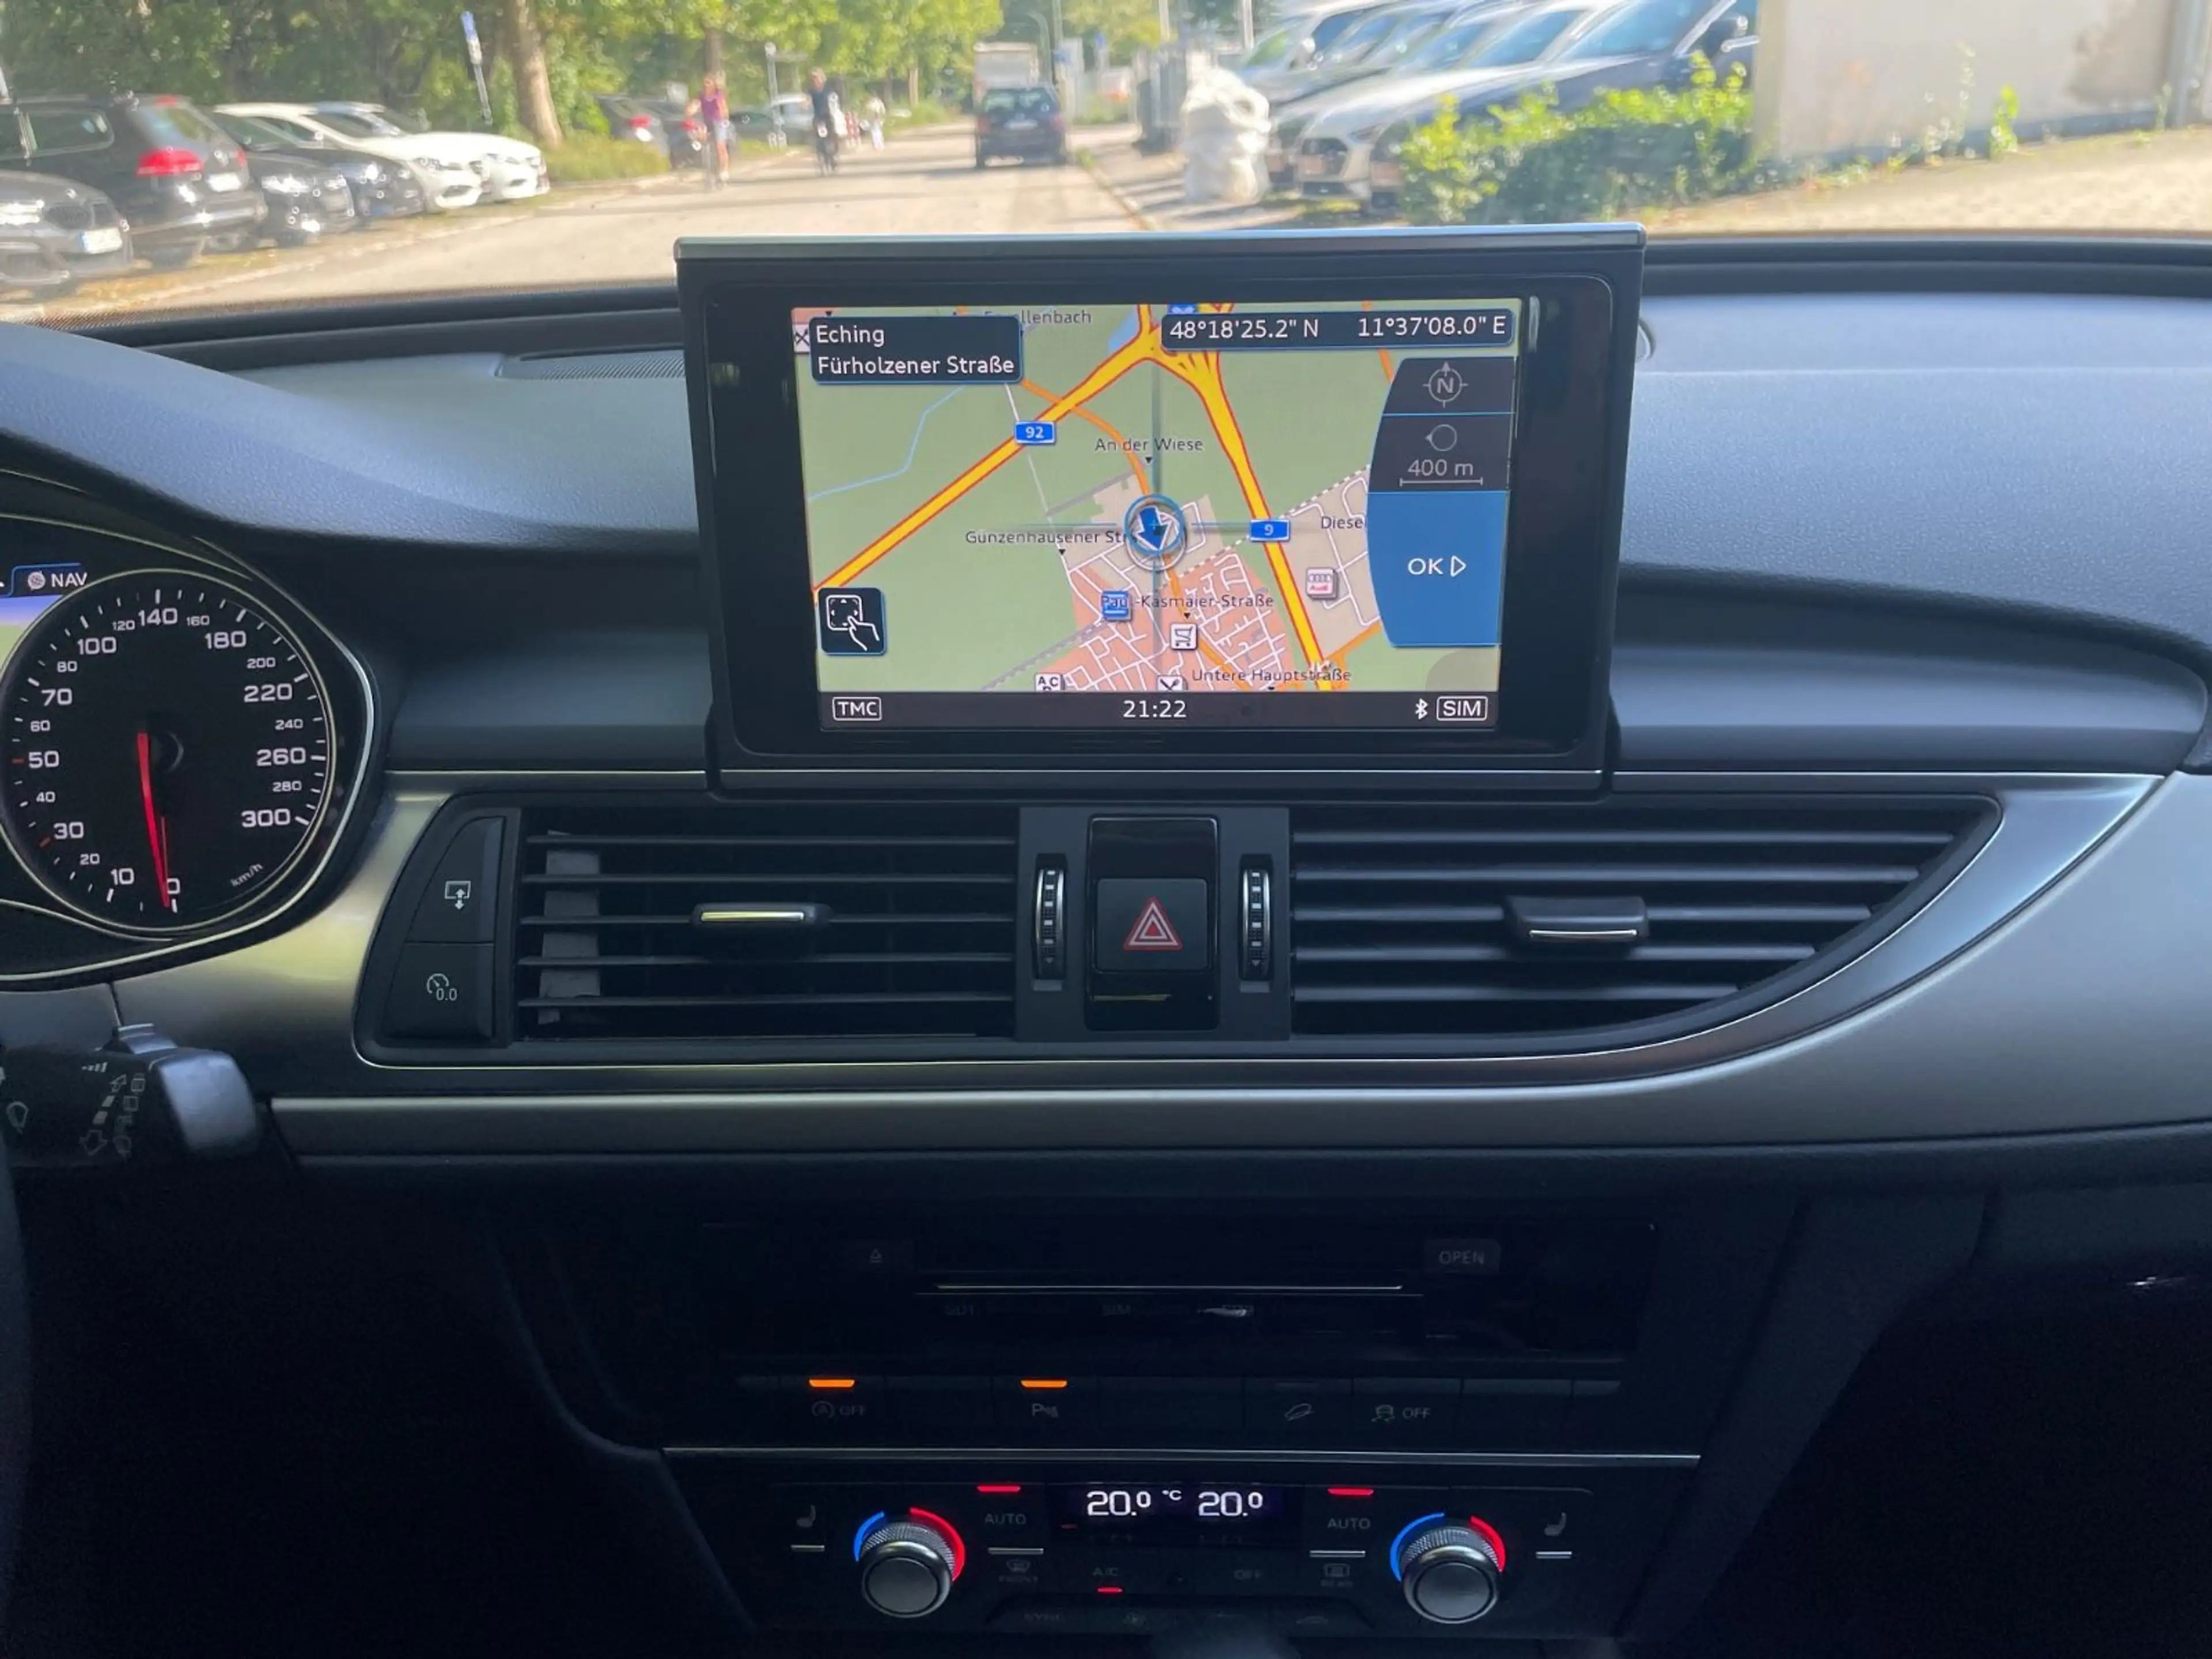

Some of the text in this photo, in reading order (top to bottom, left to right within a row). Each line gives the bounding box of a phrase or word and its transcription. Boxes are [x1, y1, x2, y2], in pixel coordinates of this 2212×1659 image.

[1304, 319, 1319, 336] N
[1493, 316, 1506, 335] E
[816, 325, 885, 347] Eching
[818, 355, 1015, 374] Fürholzener Straße
[1025, 427, 1044, 439] 92
[1094, 438, 1204, 451] An der Wiese
[1407, 460, 1474, 476] 400 m
[1264, 525, 1274, 536] 9
[1407, 558, 1444, 575] OK
[51, 572, 88, 588] NAV
[112, 619, 135, 631] 120
[138, 608, 179, 626] 140
[186, 615, 210, 627] 160
[77, 636, 117, 656] 100
[204, 630, 247, 650] 180
[56, 660, 78, 673] 80
[247, 657, 276, 669] 200
[1192, 668, 1351, 684] Untere Hauptstraße
[41, 688, 73, 706] 70
[244, 684, 293, 701] 220
[838, 702, 877, 716] TMC
[1123, 700, 1187, 718] 21:22
[1442, 700, 1482, 717] SIM
[30, 719, 51, 732] 60
[275, 719, 304, 730] 240
[28, 750, 59, 768] 50
[256, 747, 306, 766] 260
[272, 780, 302, 792] 280
[36, 790, 56, 802] 40
[241, 809, 291, 827] 300
[54, 822, 84, 840] 30
[79, 853, 100, 865] 20
[110, 868, 134, 886] 10
[231, 862, 264, 888] km/h
[1439, 1251, 1485, 1264] OPEN
[1402, 1407, 1431, 1419] OFF
[1087, 1490, 1152, 1516] 20.0
[1198, 1491, 1263, 1517] 20.0
[984, 1513, 1027, 1525] AUTO
[1327, 1518, 1371, 1530] AUTO
